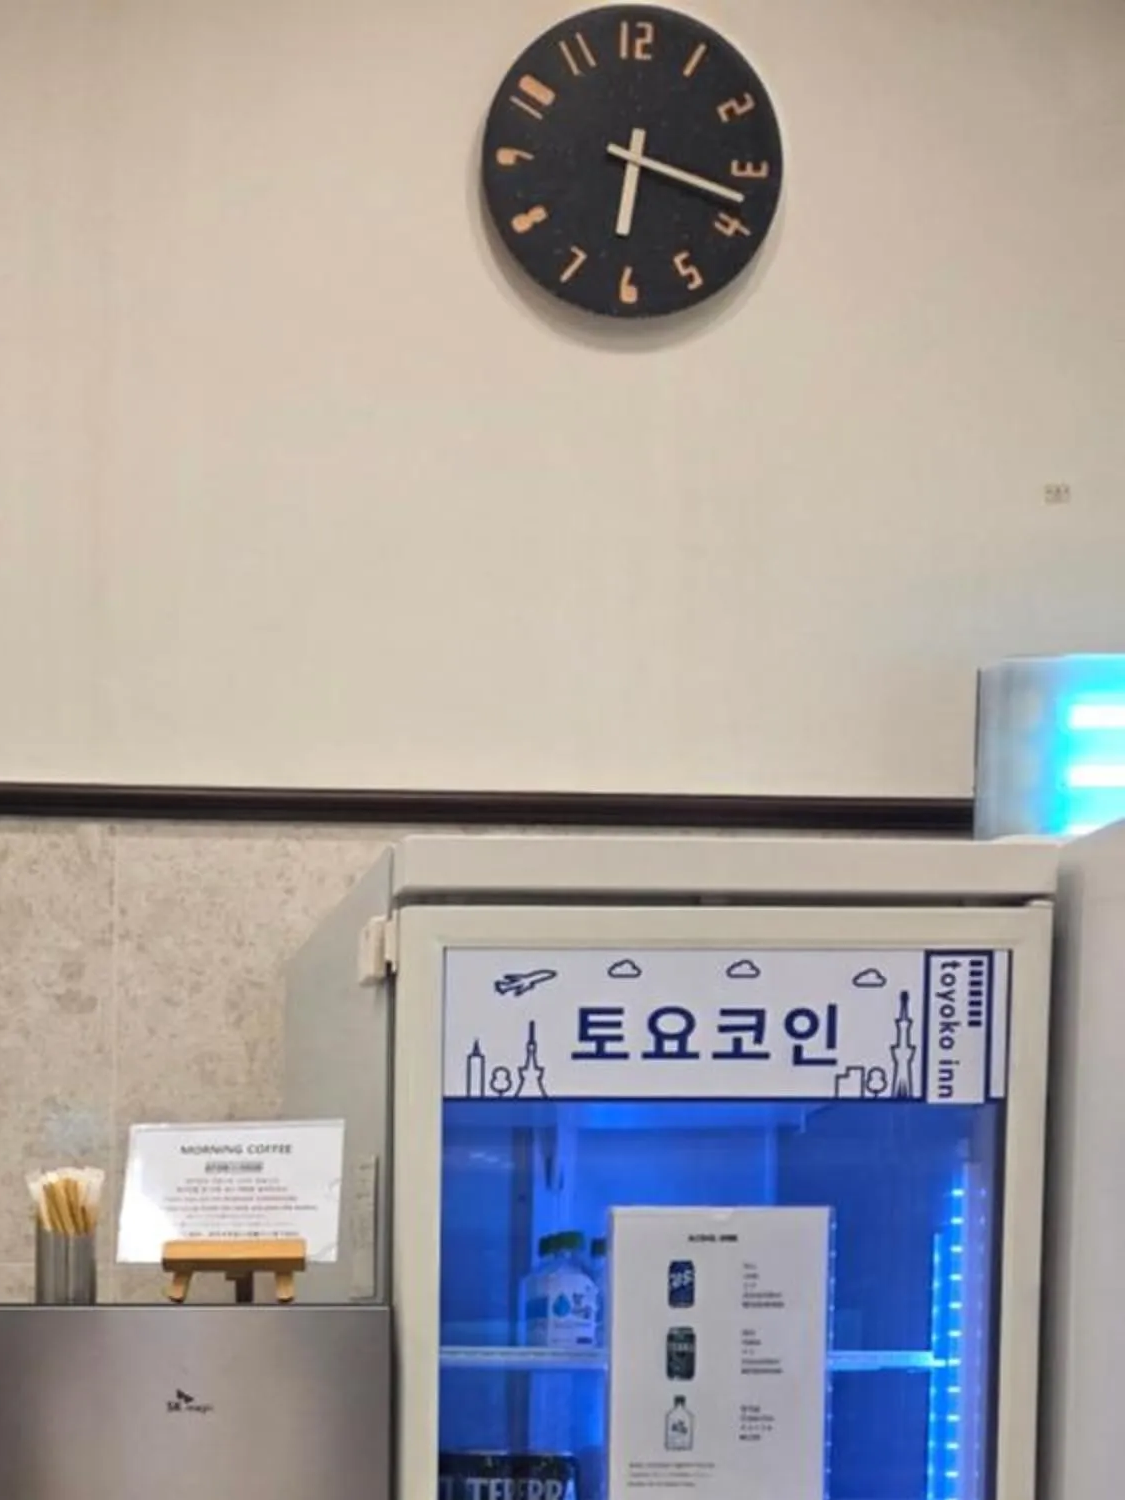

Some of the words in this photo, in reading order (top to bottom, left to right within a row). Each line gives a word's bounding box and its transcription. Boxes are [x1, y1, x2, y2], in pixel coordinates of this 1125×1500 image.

[559, 31, 597, 76] 11
[619, 20, 655, 61] 12
[682, 43, 707, 77] 1
[509, 73, 557, 121] 10
[716, 92, 756, 123] 2
[495, 147, 535, 167] 9
[730, 159, 769, 179] 3
[511, 204, 549, 234] 8
[713, 211, 752, 237] 4
[560, 244, 588, 283] 7
[673, 250, 704, 291] 5
[619, 265, 639, 305] 6
[935, 959, 962, 1050] toyoko
[570, 1002, 840, 1068] 토요코인
[937, 1053, 961, 1100] inn
[246, 1143, 293, 1155] COFFEE
